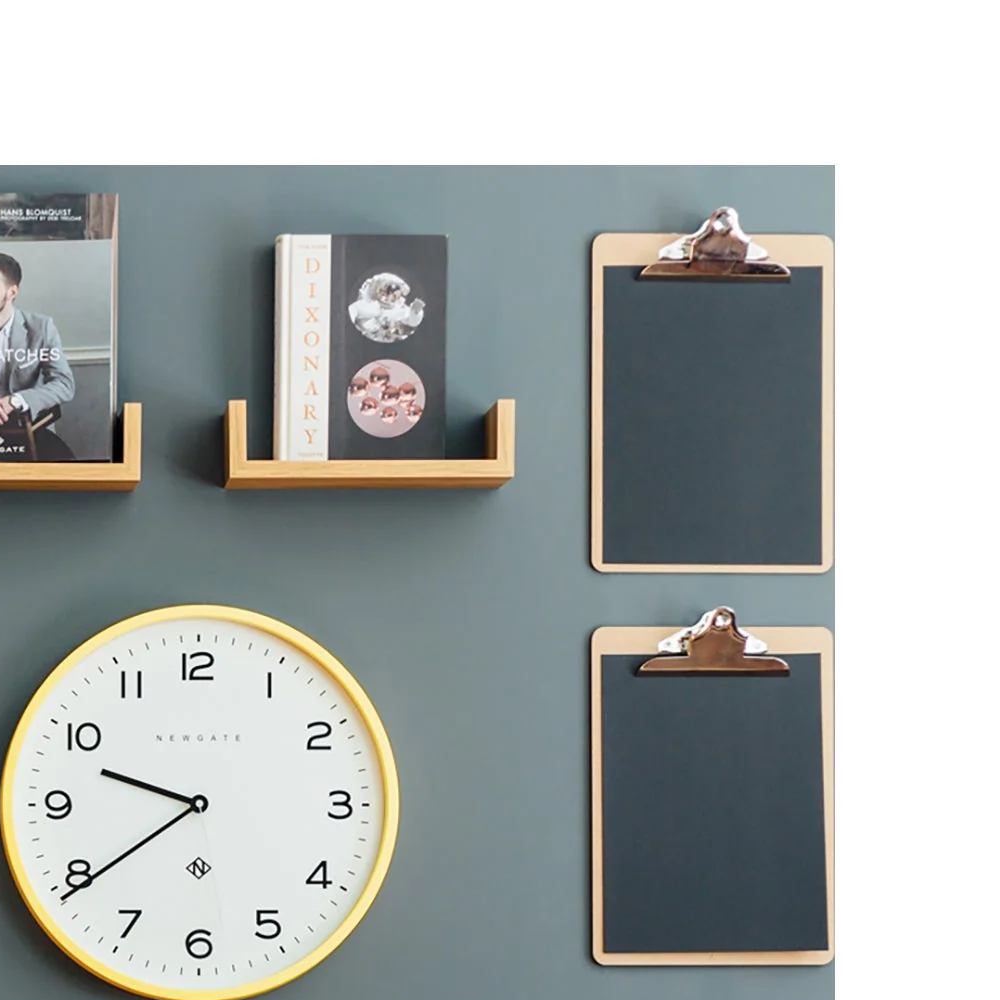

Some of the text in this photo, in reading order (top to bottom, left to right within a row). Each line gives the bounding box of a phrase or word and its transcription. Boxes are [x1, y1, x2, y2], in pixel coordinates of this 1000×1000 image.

[0, 208, 71, 217] HANS BLOMQUIST
[303, 257, 321, 444] DIXONARY
[181, 651, 215, 681] 12
[120, 670, 142, 699] 11
[267, 671, 272, 699] 1
[67, 722, 102, 752] 10
[156, 734, 241, 742] NEWGATE
[306, 721, 332, 751] 2
[44, 789, 73, 820] 9
[327, 790, 353, 820] 3
[64, 859, 93, 889] 8
[305, 860, 333, 890] 4
[118, 909, 143, 939] 7
[254, 909, 282, 940] 5
[185, 928, 213, 960] 6
